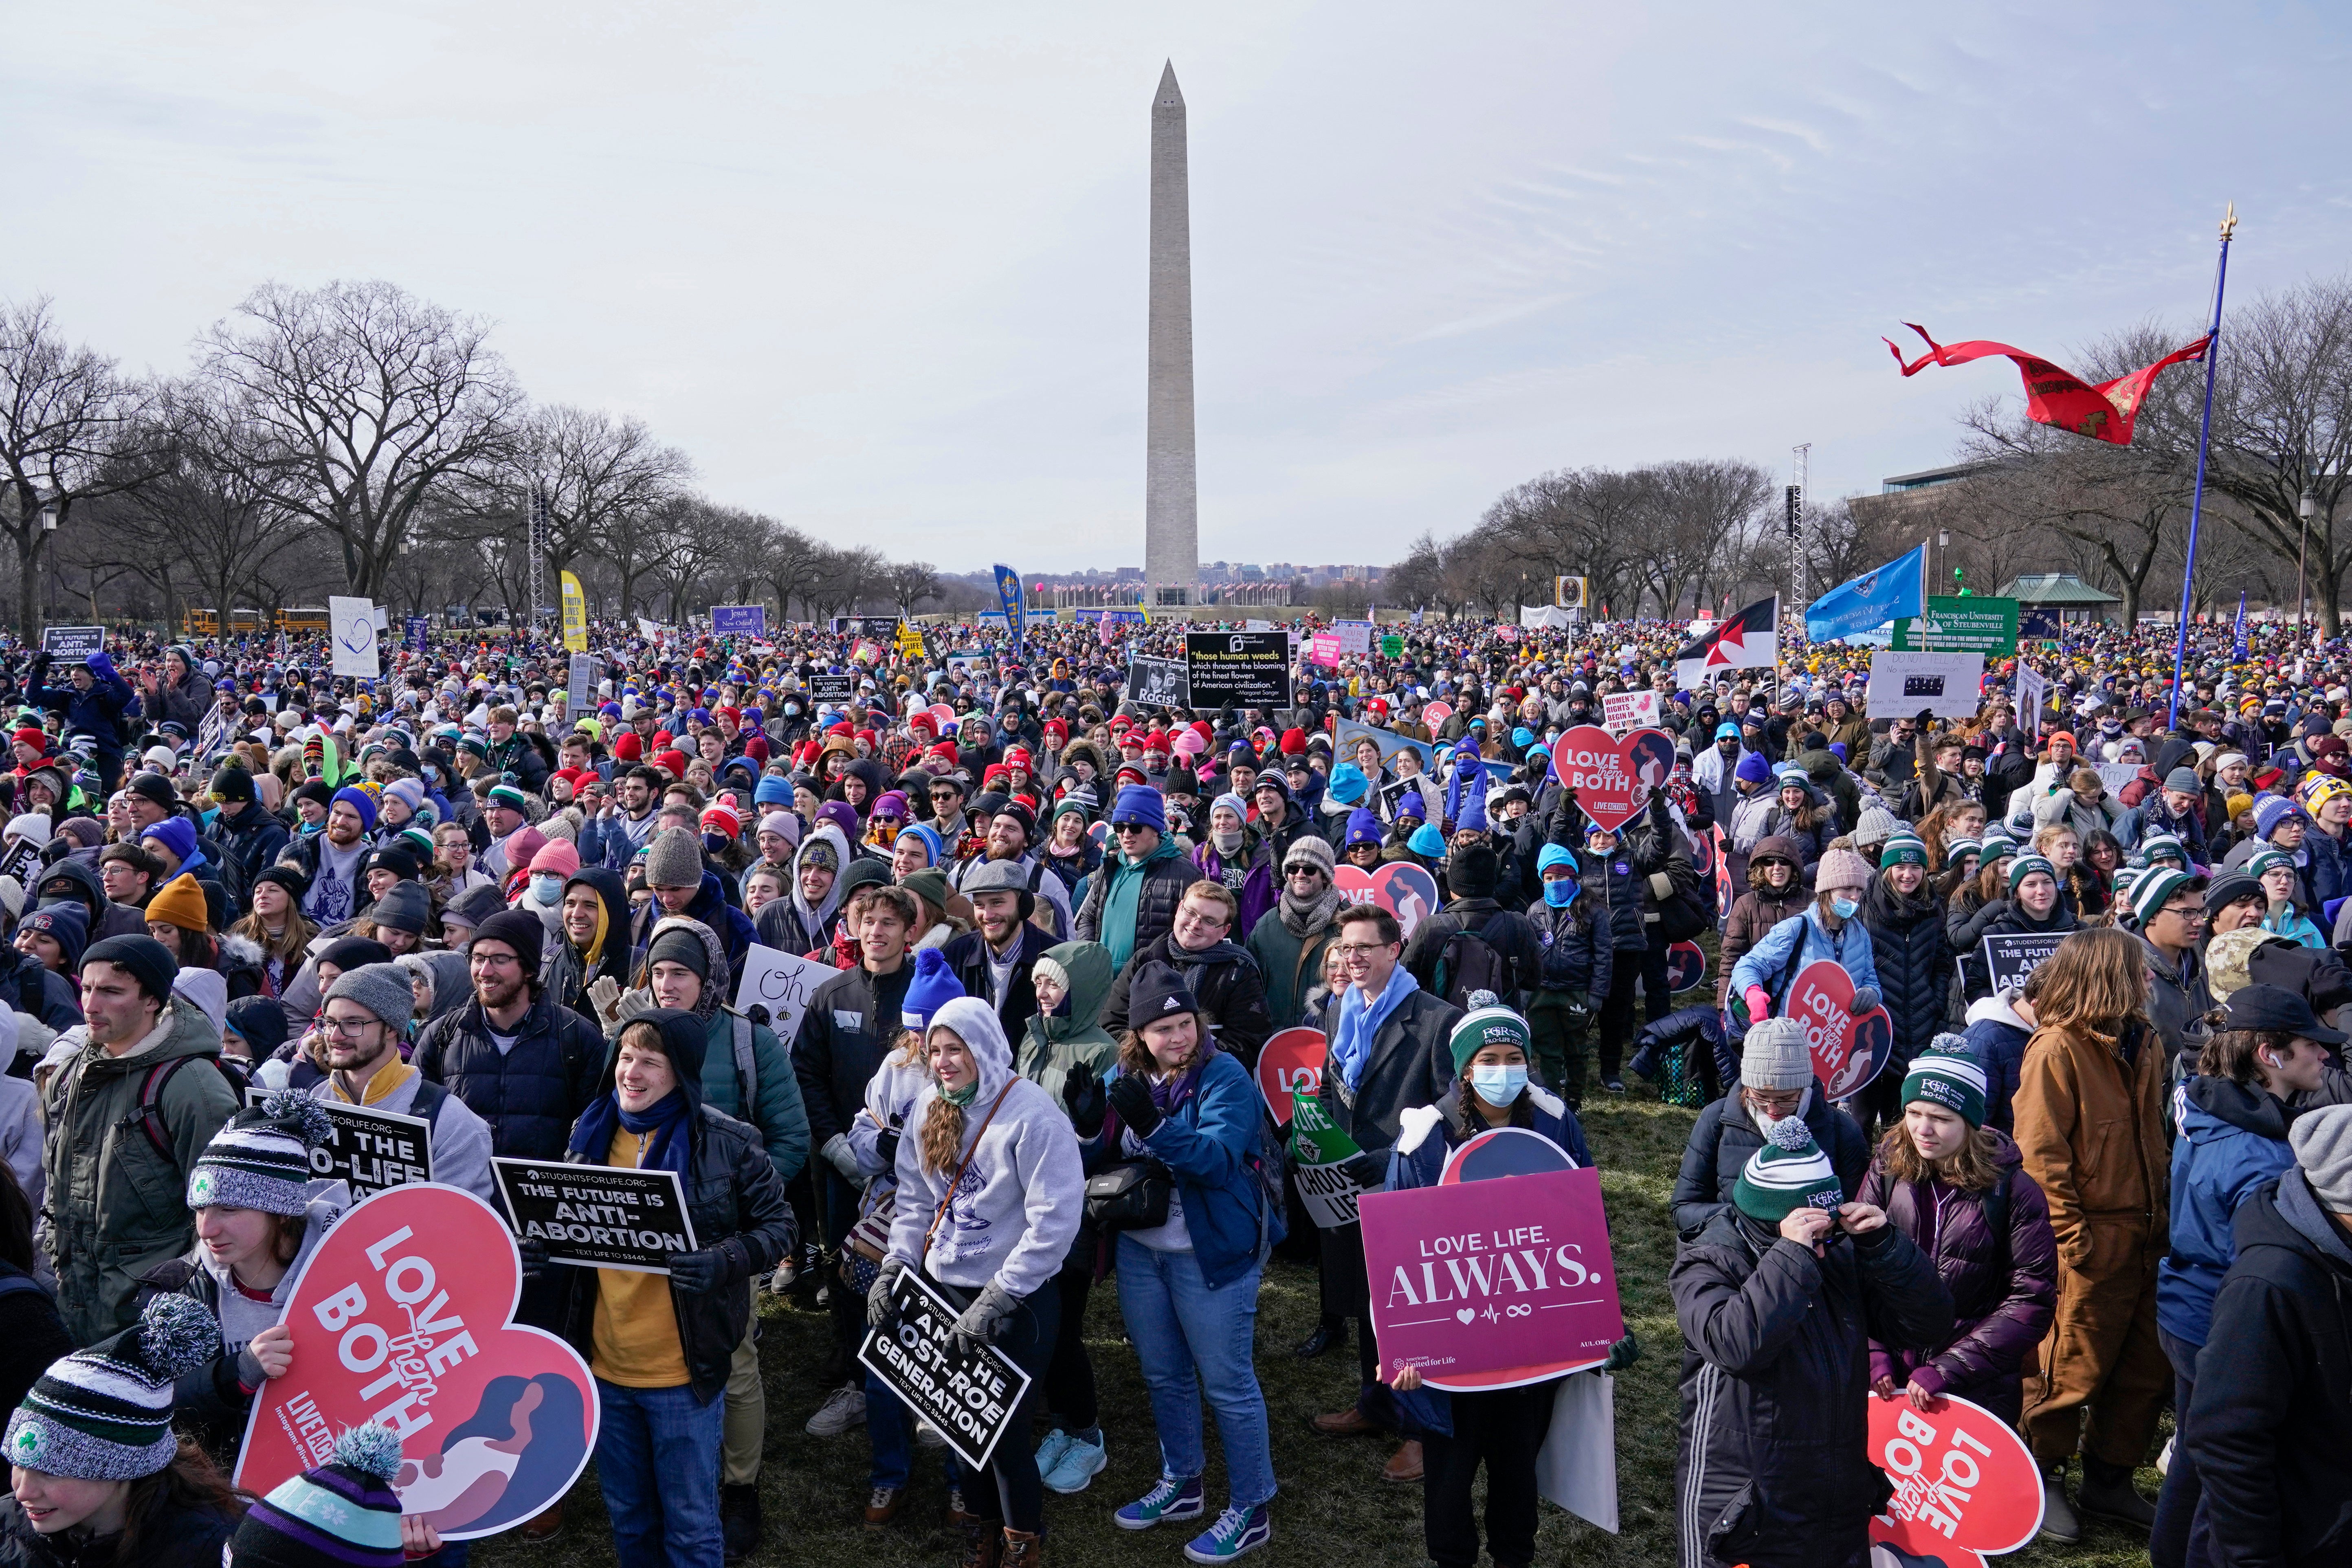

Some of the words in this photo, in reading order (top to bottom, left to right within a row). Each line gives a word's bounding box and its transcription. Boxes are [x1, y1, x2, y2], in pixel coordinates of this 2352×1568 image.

[564, 597, 581, 605] TRUTH
[565, 607, 579, 616] LIVES
[729, 609, 747, 620] Jesuit
[1931, 610, 1969, 620] FRANCISCAN
[1969, 611, 2004, 621] UNIVERSITY
[565, 617, 578, 625] HERE
[1953, 620, 2004, 629] STEUBENVILLE
[2044, 617, 2059, 631] MARY
[48, 647, 100, 656] ABORTION
[58, 640, 88, 648] ANTI-
[859, 641, 878, 650] UNBORN
[1134, 657, 1166, 668] Margaret
[1220, 651, 1249, 660] human
[1251, 650, 1279, 660] weeds
[1892, 654, 1905, 663] DO
[1908, 654, 1924, 663] NOT
[1930, 654, 1949, 664] TELL
[1953, 654, 1968, 664] ME
[1253, 661, 1286, 671] blooming
[1192, 671, 1199, 679] of
[1231, 671, 1255, 679] flowers
[1139, 688, 1177, 705] Racist
[1605, 694, 1635, 706] WOMEN'S
[1606, 704, 1630, 714] RIGHTS
[1607, 713, 1627, 722] BEGIN
[1609, 721, 1621, 730] THE
[1566, 748, 1620, 770] LOVE
[1589, 763, 1624, 778] them
[1572, 771, 1630, 791] BOTH
[1594, 801, 1608, 810] LIVE
[11, 849, 36, 875] THE
[1998, 949, 2022, 958] THE
[760, 964, 807, 1008] Oh
[1802, 982, 1851, 1036] LOVE
[1820, 1012, 1843, 1049] them
[1484, 1036, 1511, 1045] PRO-LIFE
[1511, 1038, 1523, 1047] CLUB
[1920, 1090, 1948, 1103] PRO-LIFE
[1948, 1099, 1962, 1111] CLUB
[354, 1131, 416, 1161] THE
[539, 1171, 647, 1188] STUDENTSFORLIFE.ORG
[518, 1183, 558, 1198] THE
[562, 1186, 640, 1205] FUTURE
[644, 1193, 664, 1207] IS
[555, 1202, 640, 1226] ANTI-
[526, 1220, 687, 1252] ABORTION
[1418, 1233, 1488, 1257] LOVE.
[1493, 1225, 1550, 1247] LIFE.
[622, 1253, 646, 1262] 53445
[1385, 1243, 1602, 1309] ALWAYS.
[365, 1225, 479, 1377] LOVE
[899, 1295, 911, 1312] I
[312, 1282, 434, 1441] BOTH
[387, 1302, 438, 1405] them
[1405, 1359, 1431, 1369] United
[1442, 1356, 1457, 1365] Life
[876, 1335, 989, 1445] GENERATION
[898, 1377, 912, 1392] TEXT
[911, 1388, 923, 1403] LIFE
[923, 1399, 932, 1410] TO
[930, 1407, 949, 1427] 53445
[286, 1390, 319, 1437] LIVE
[275, 1405, 299, 1445] Instagram:
[1917, 1427, 1992, 1539] LOVE
[1895, 1466, 1948, 1522] them
